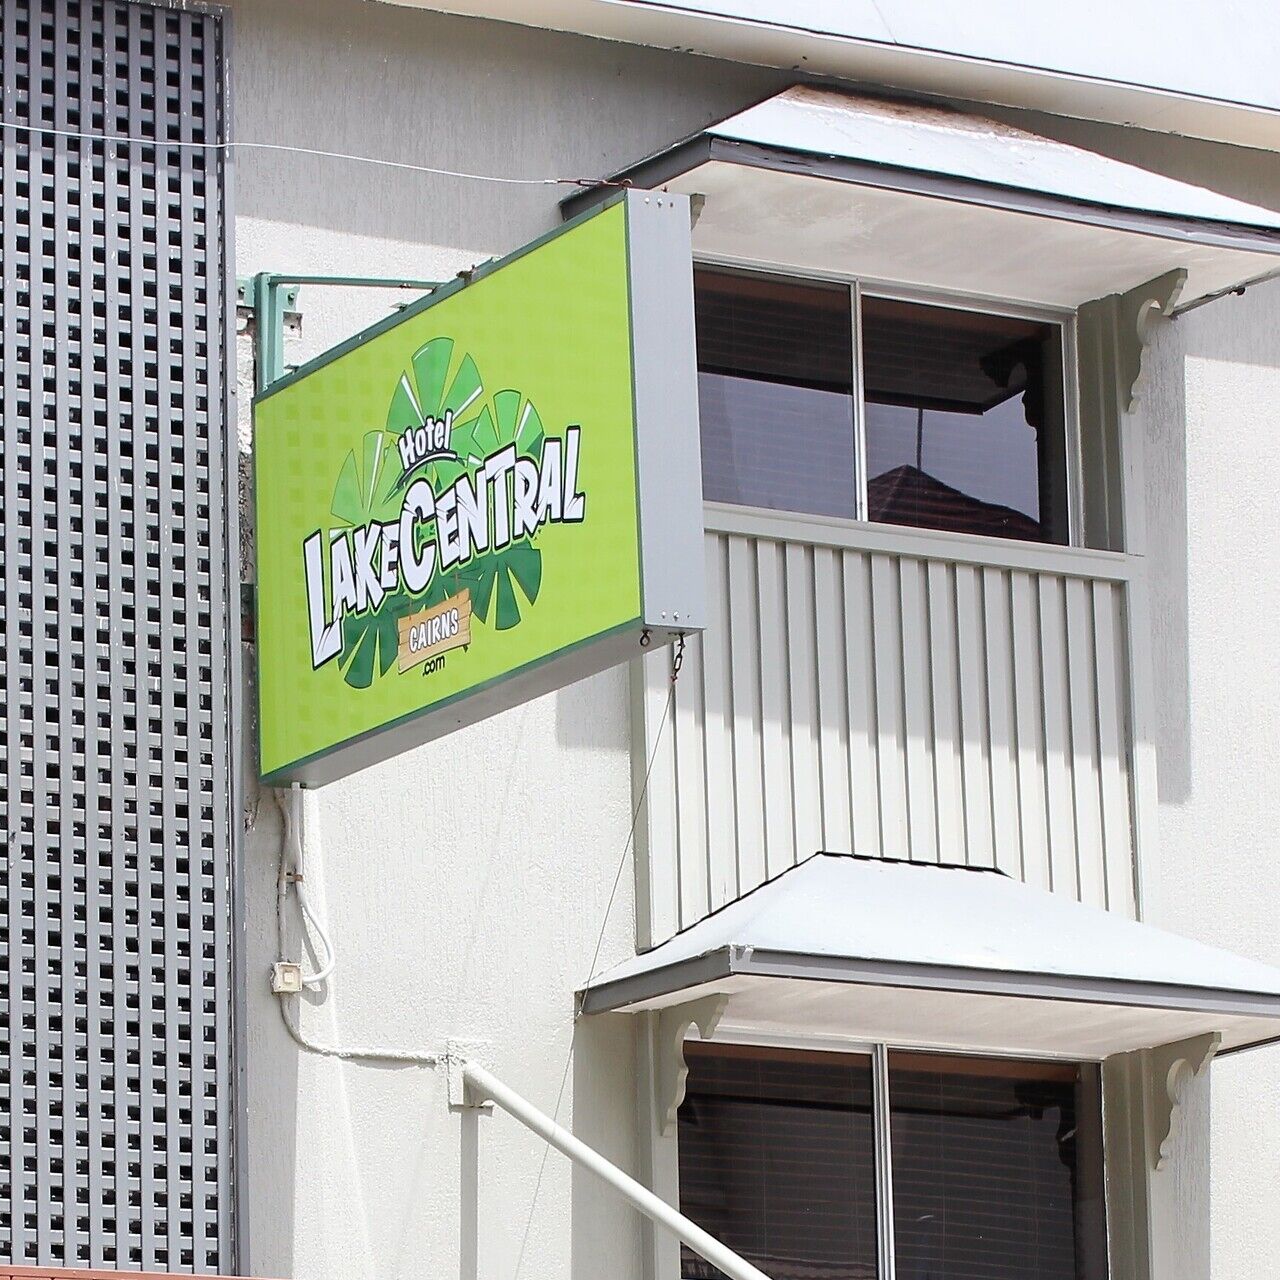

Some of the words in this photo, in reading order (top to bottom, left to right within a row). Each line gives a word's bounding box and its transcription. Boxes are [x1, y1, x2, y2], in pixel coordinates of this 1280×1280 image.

[398, 409, 453, 468] Hotel
[408, 607, 460, 652] CAIRNS
[422, 654, 446, 677] .com
